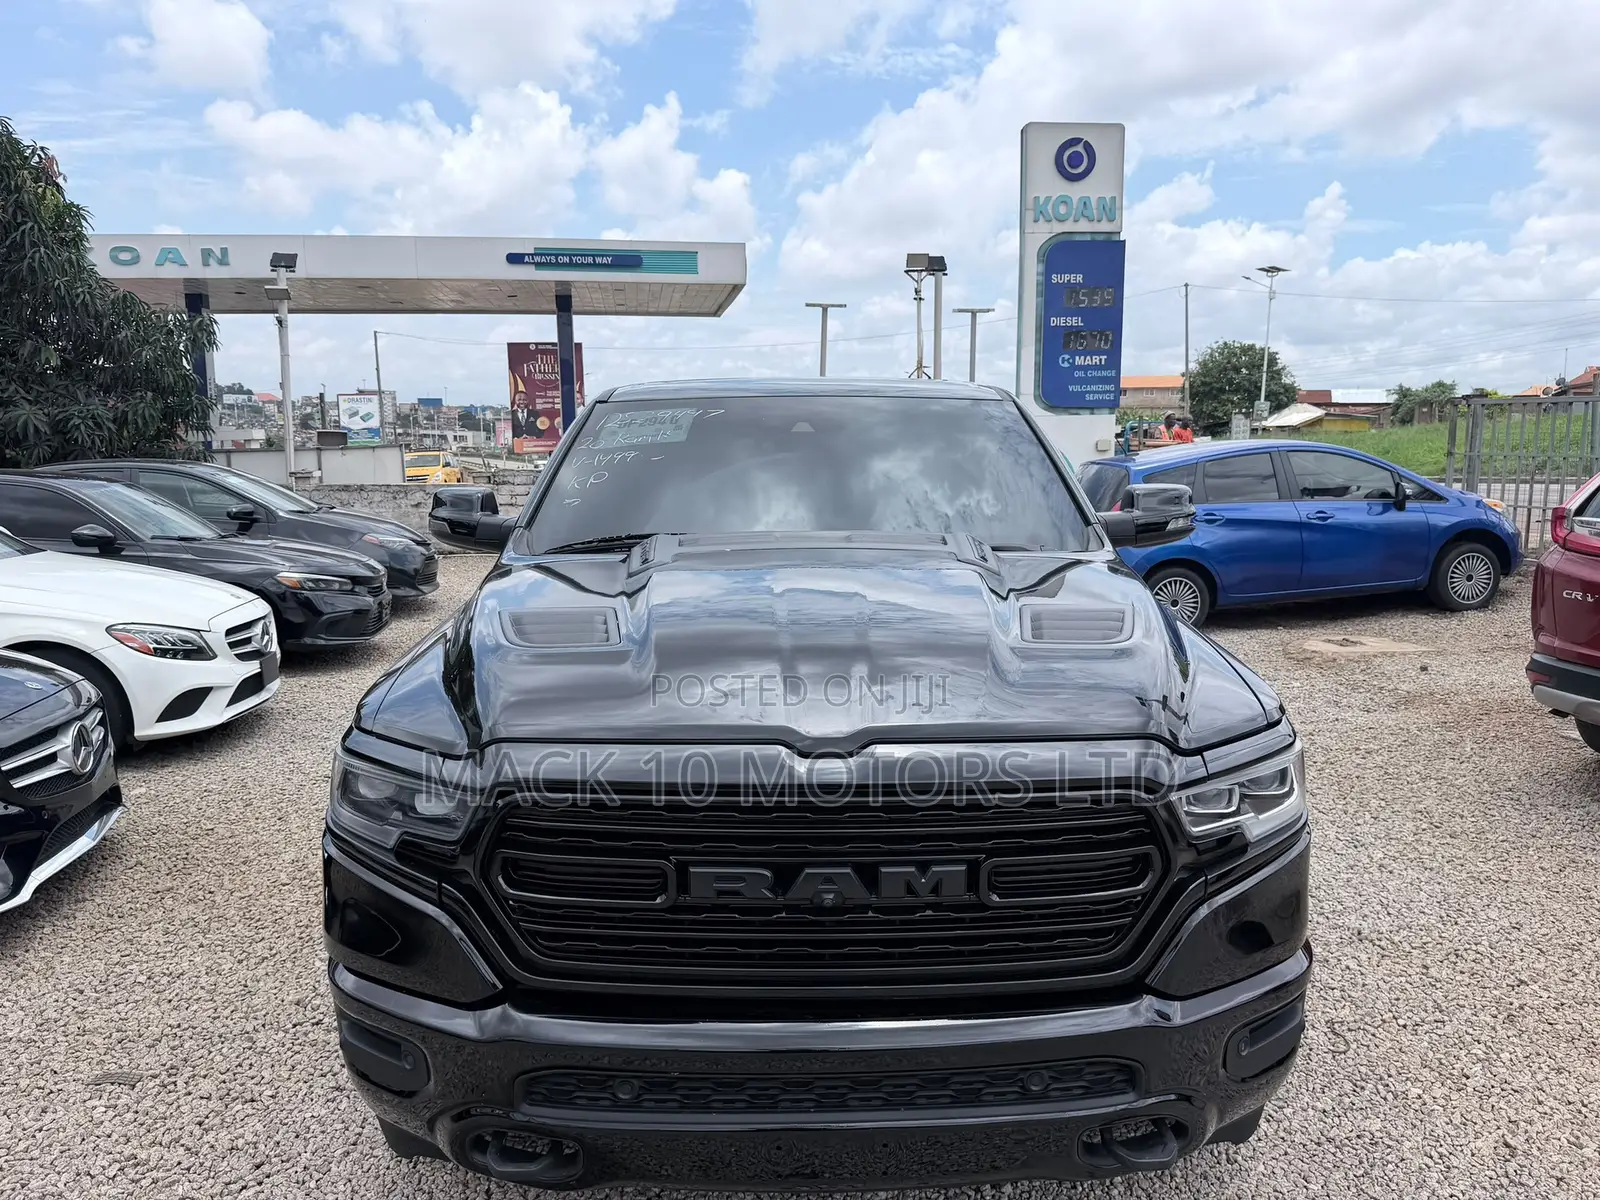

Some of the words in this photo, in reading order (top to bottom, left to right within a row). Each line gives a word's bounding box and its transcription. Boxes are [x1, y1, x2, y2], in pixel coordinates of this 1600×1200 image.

[1033, 194, 1117, 223] KOAN
[88, 245, 231, 267] OAN
[524, 255, 556, 264] ALWAYS
[558, 256, 570, 264] ON
[571, 256, 594, 265] YOUR
[595, 257, 613, 265] WAY
[1051, 273, 1083, 284] SUPER
[1050, 316, 1084, 327] DIESEL
[1074, 355, 1107, 366] MART
[1074, 370, 1086, 378] OIL
[1086, 369, 1117, 378] CHANGE
[1068, 384, 1115, 392] VULCANIZING
[1085, 393, 1115, 401] SERVICE
[688, 866, 968, 898] RAM
